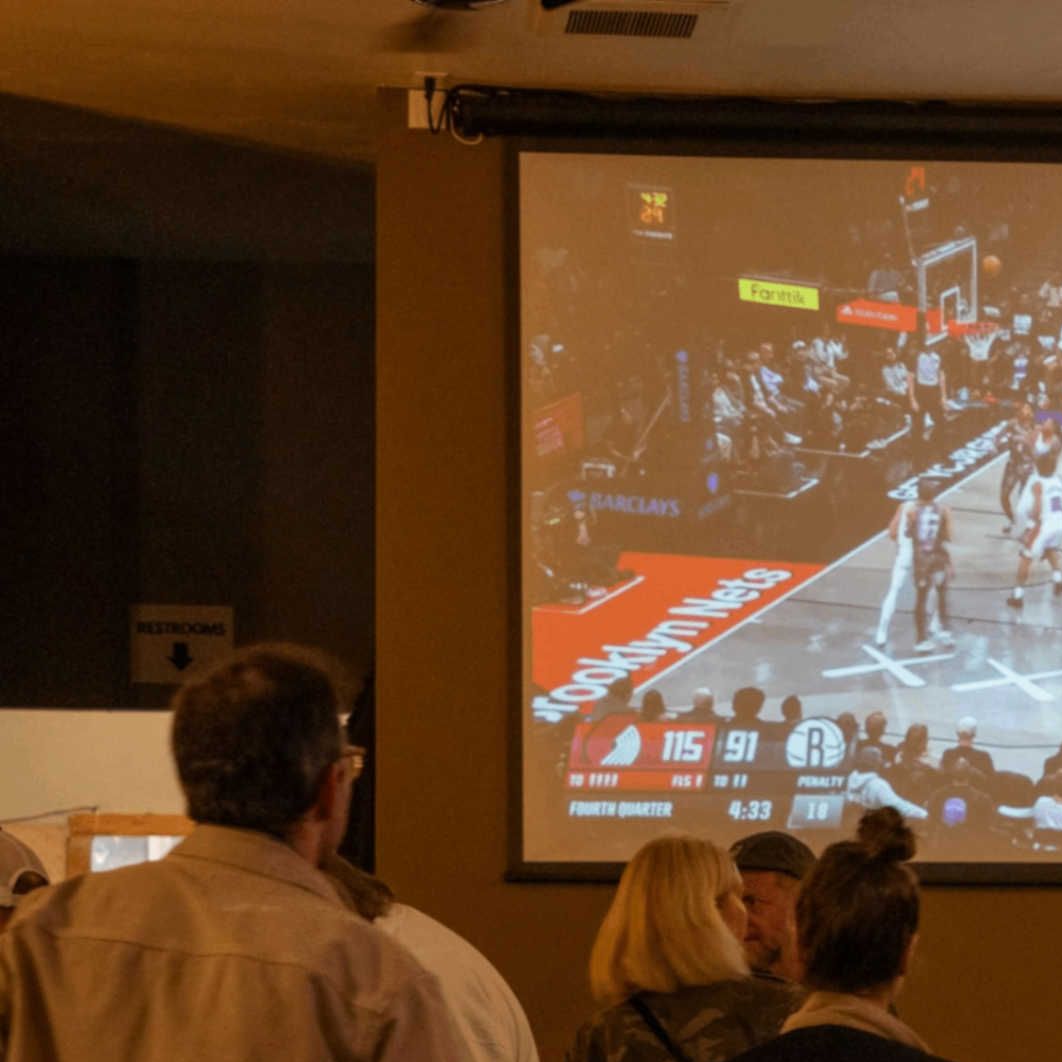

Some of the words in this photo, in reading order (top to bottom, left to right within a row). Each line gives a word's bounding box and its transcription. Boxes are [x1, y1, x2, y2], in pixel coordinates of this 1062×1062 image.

[750, 283, 806, 305] Fanttik
[590, 493, 681, 517] BARCLAYS
[137, 621, 226, 636] RESTROOMS
[532, 620, 710, 723] rooklyn
[668, 567, 793, 619] Nets
[661, 730, 706, 762] 115
[723, 729, 760, 763] 91
[569, 800, 617, 817] FOURTH
[617, 801, 673, 819] QUARTER
[728, 799, 773, 820] 4:33
